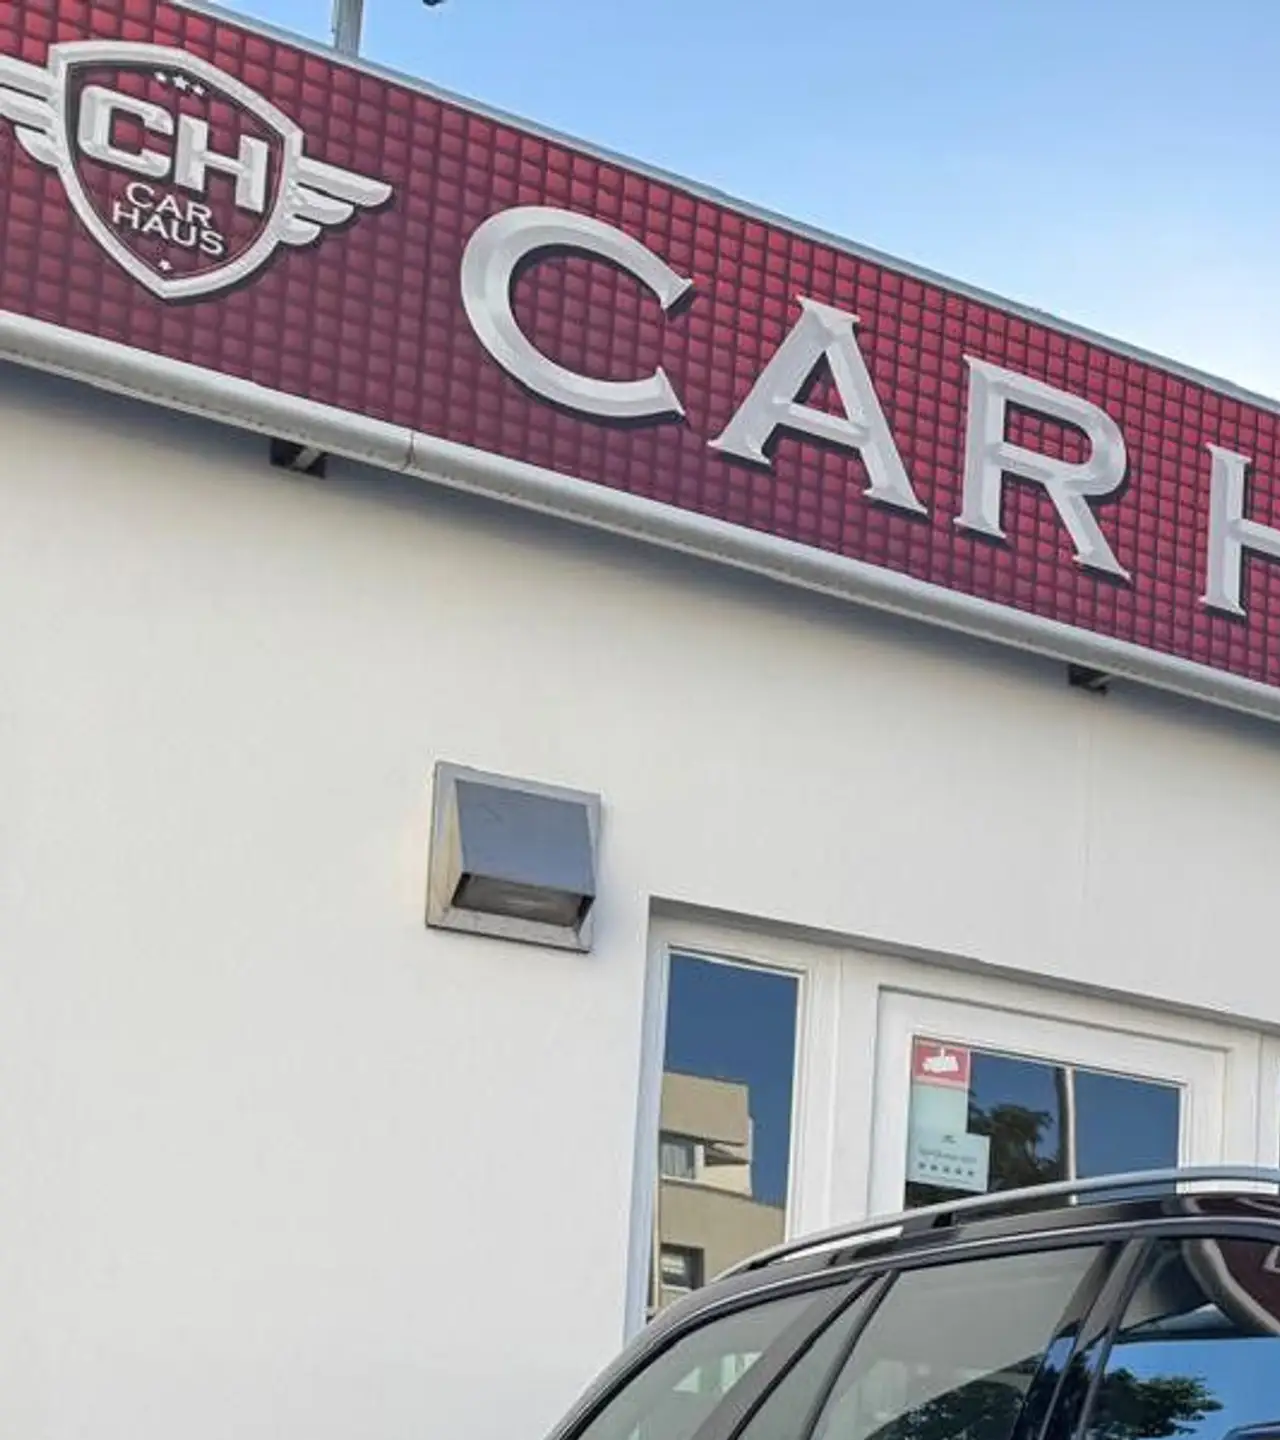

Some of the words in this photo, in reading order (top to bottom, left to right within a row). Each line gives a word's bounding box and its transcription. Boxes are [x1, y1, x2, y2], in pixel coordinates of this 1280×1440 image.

[77, 85, 269, 213] CH
[112, 201, 225, 256] HAUS
[126, 182, 213, 229] CAR
[460, 205, 1132, 583] CAR
